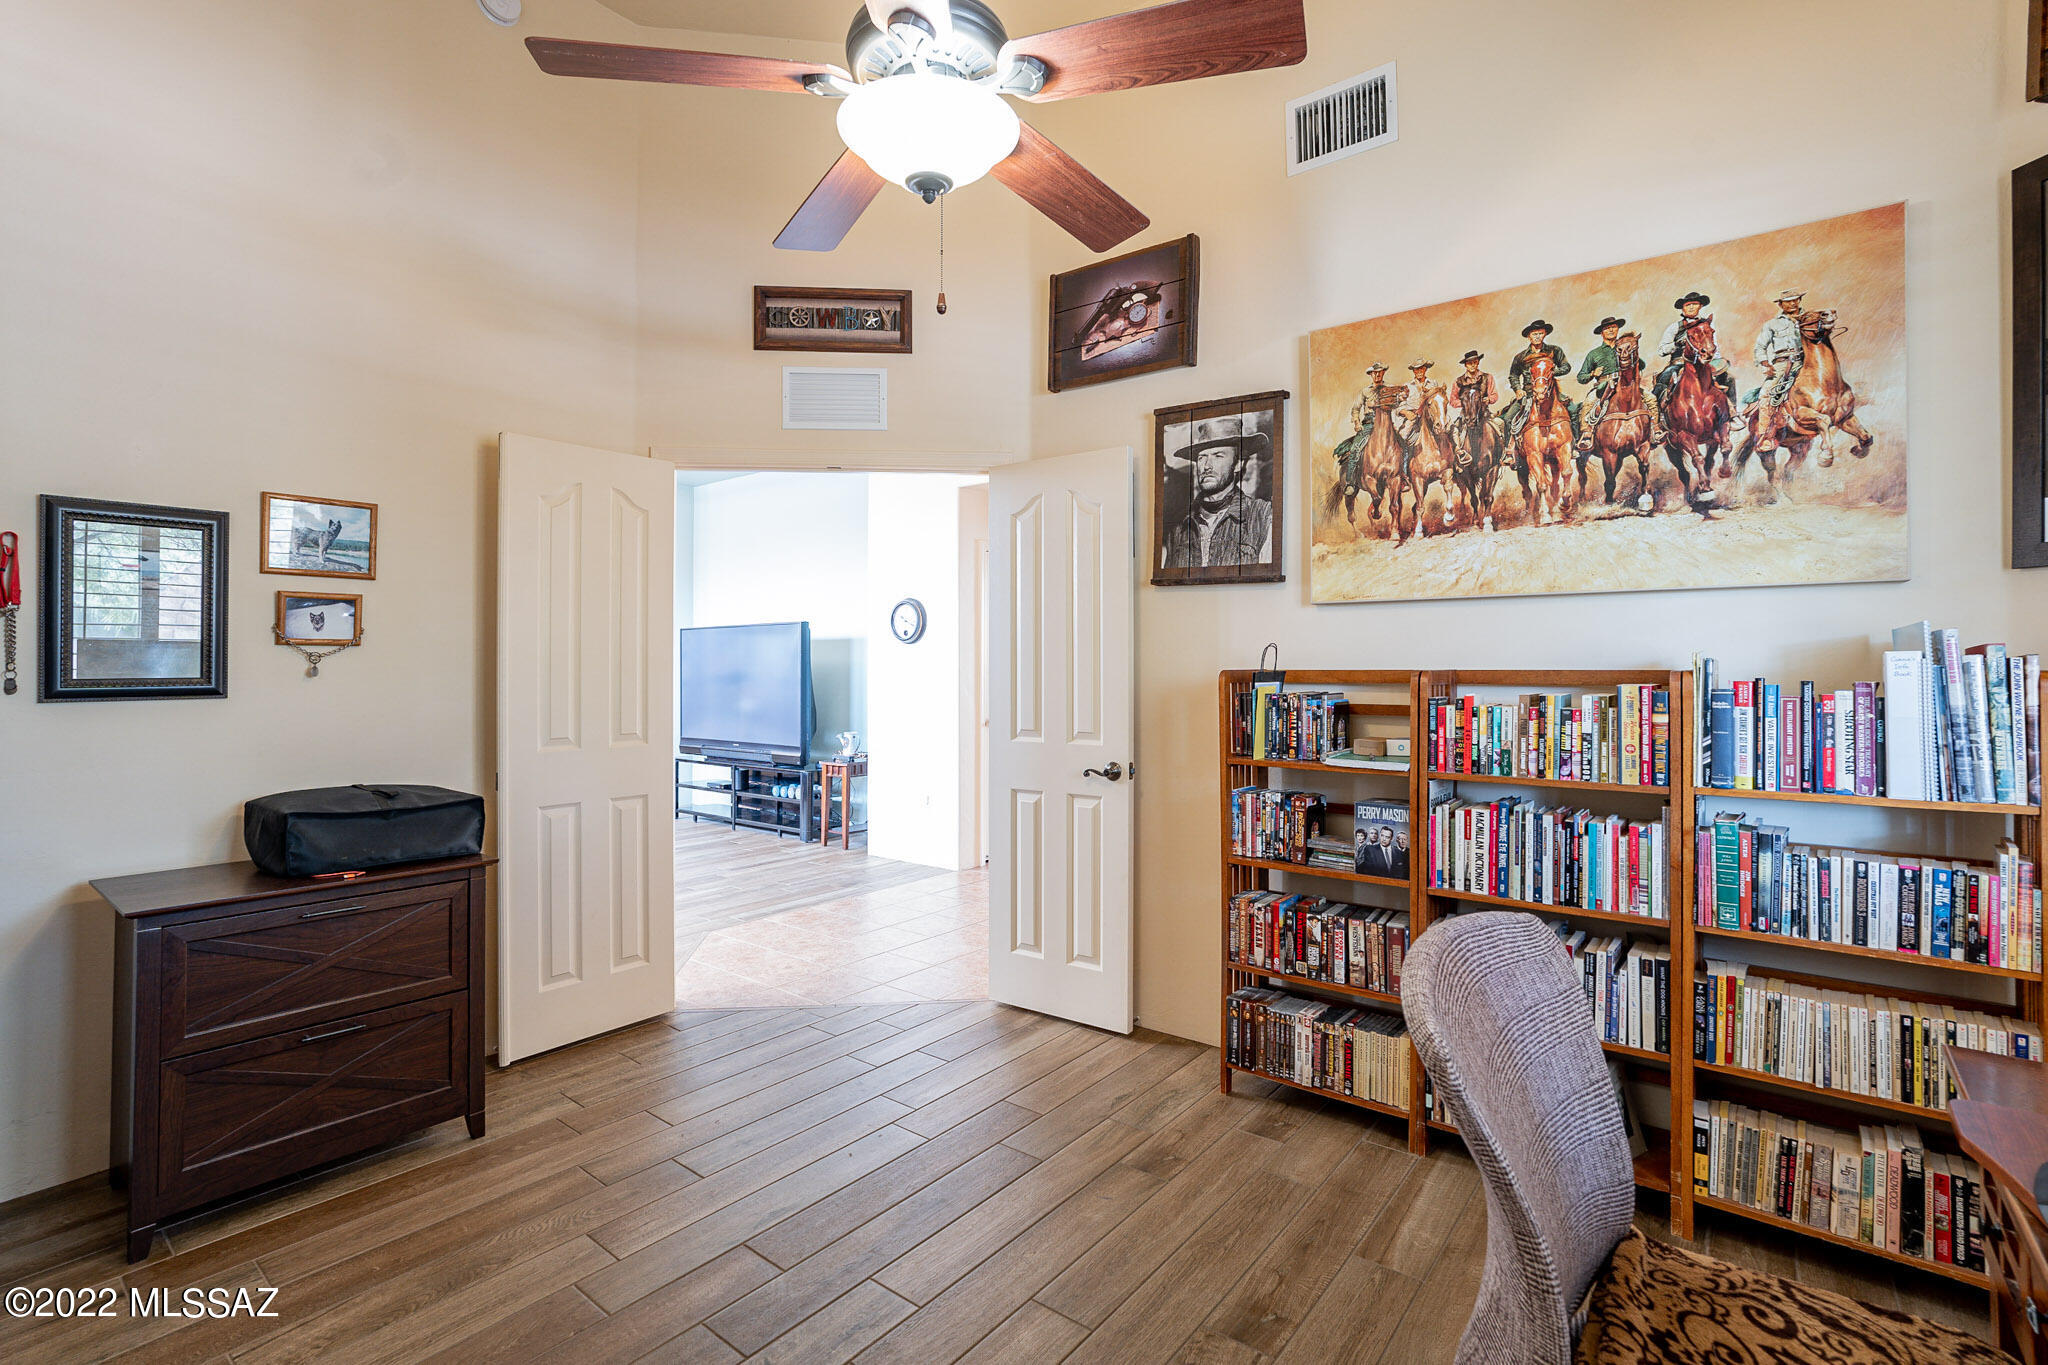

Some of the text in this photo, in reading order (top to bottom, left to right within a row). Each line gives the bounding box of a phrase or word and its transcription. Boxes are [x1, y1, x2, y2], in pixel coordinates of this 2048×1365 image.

[1844, 709, 1854, 775] SHOOTING STAR
[2013, 658, 2024, 761] THE JOHN WAYNE SCRAPBOOK
[1357, 806, 1381, 820] PERRY
[1382, 808, 1410, 823] MASON
[1475, 811, 1484, 891] MACMILLAN DICTIONARY
[1889, 1165, 1899, 1208] DEADWOOD
